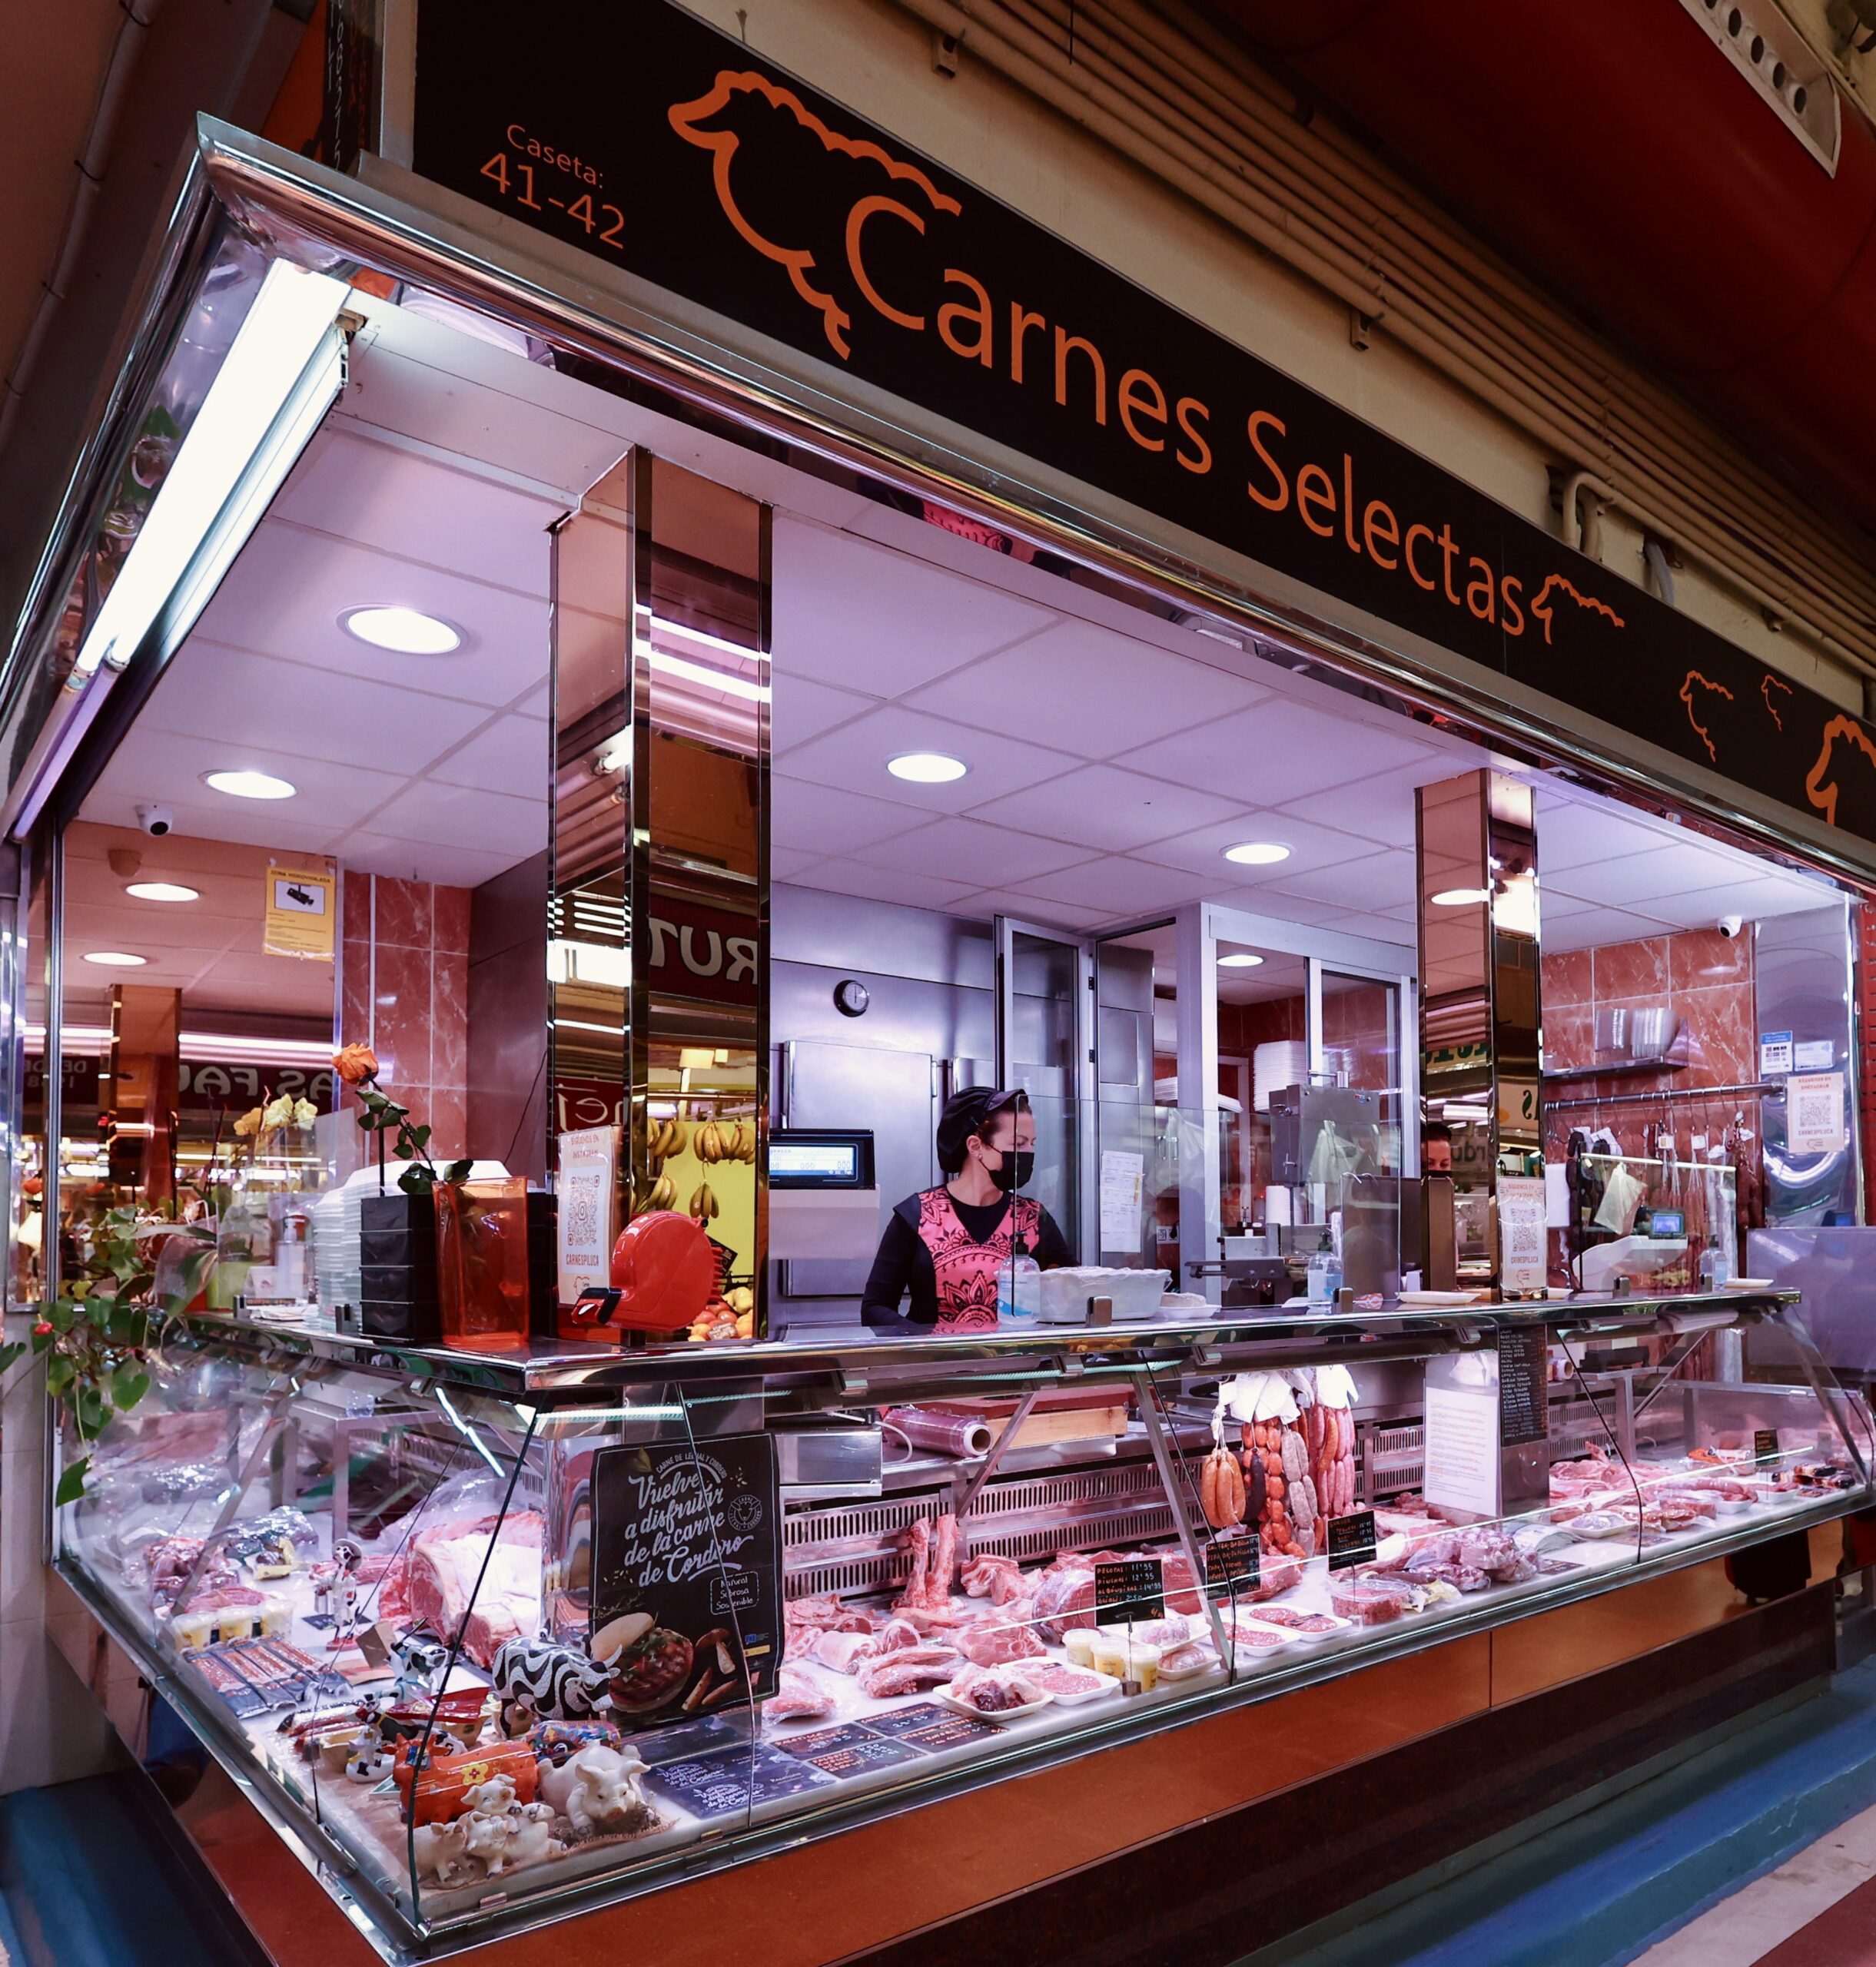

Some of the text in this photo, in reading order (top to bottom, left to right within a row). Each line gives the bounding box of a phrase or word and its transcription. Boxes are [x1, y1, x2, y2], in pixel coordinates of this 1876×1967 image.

[506, 124, 603, 189] Caseta:
[480, 152, 625, 249] 41-42
[845, 195, 1526, 636] Carnes Selectas
[628, 1471, 700, 1510] Vuelve
[656, 1456, 675, 1474] CARNE
[674, 1453, 683, 1462] DE
[624, 1511, 725, 1567] de la carne
[639, 1561, 664, 1587] de
